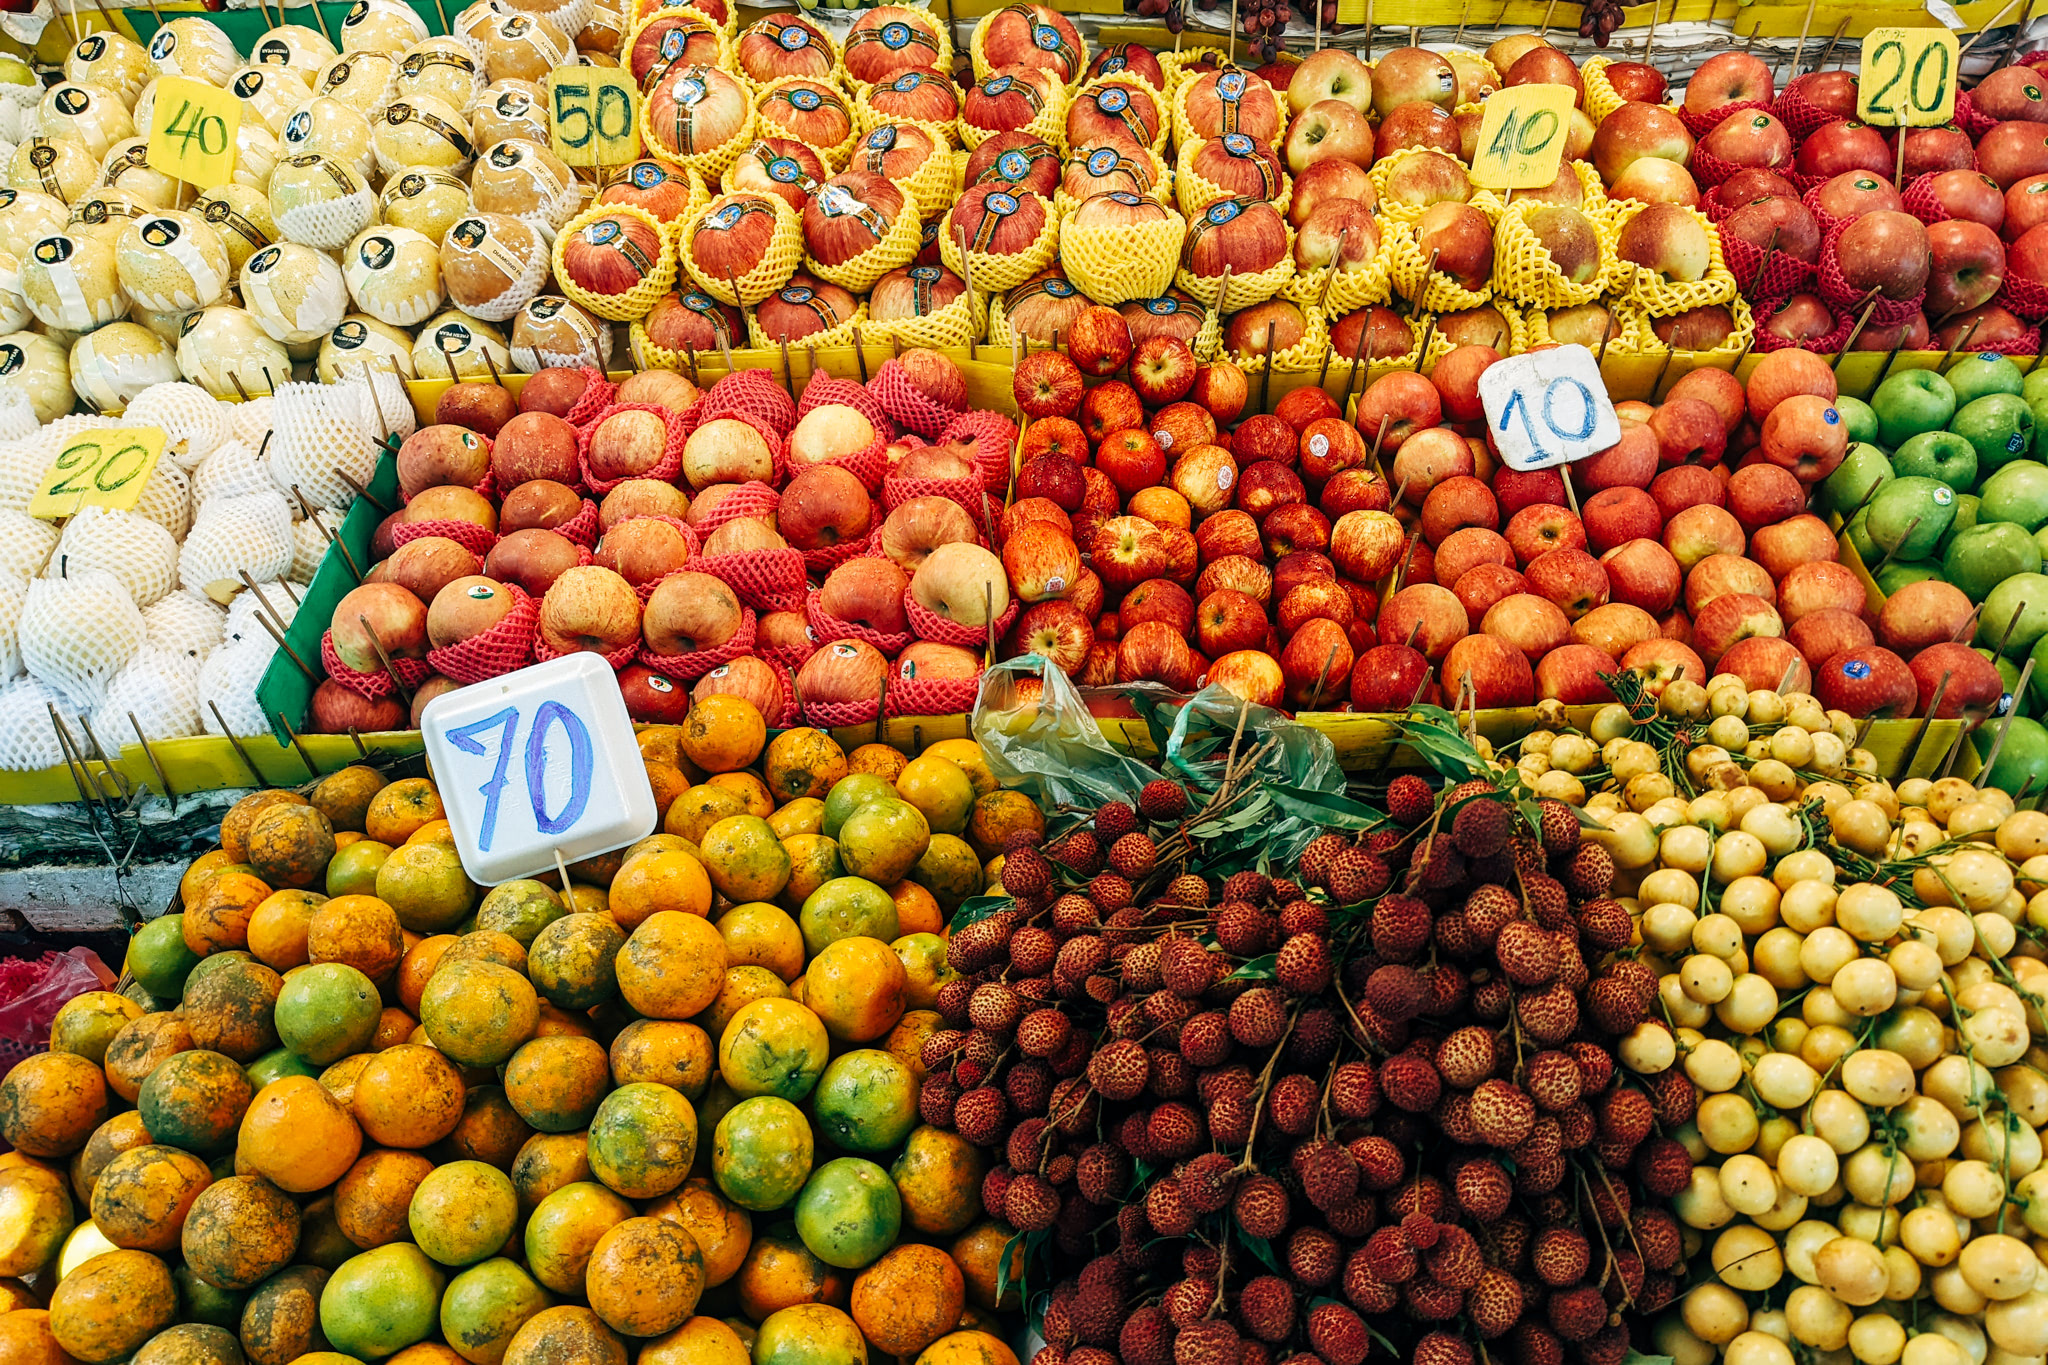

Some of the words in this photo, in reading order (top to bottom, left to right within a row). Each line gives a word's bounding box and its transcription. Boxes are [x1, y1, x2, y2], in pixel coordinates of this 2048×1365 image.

[1867, 41, 1949, 114] 20
[164, 99, 228, 160] 40
[554, 84, 632, 149] 50
[1486, 106, 1559, 170] 40
[492, 249, 517, 271] DIAMOND
[1499, 376, 1598, 463] 10
[48, 442, 149, 496] 20
[445, 700, 594, 852] 70
